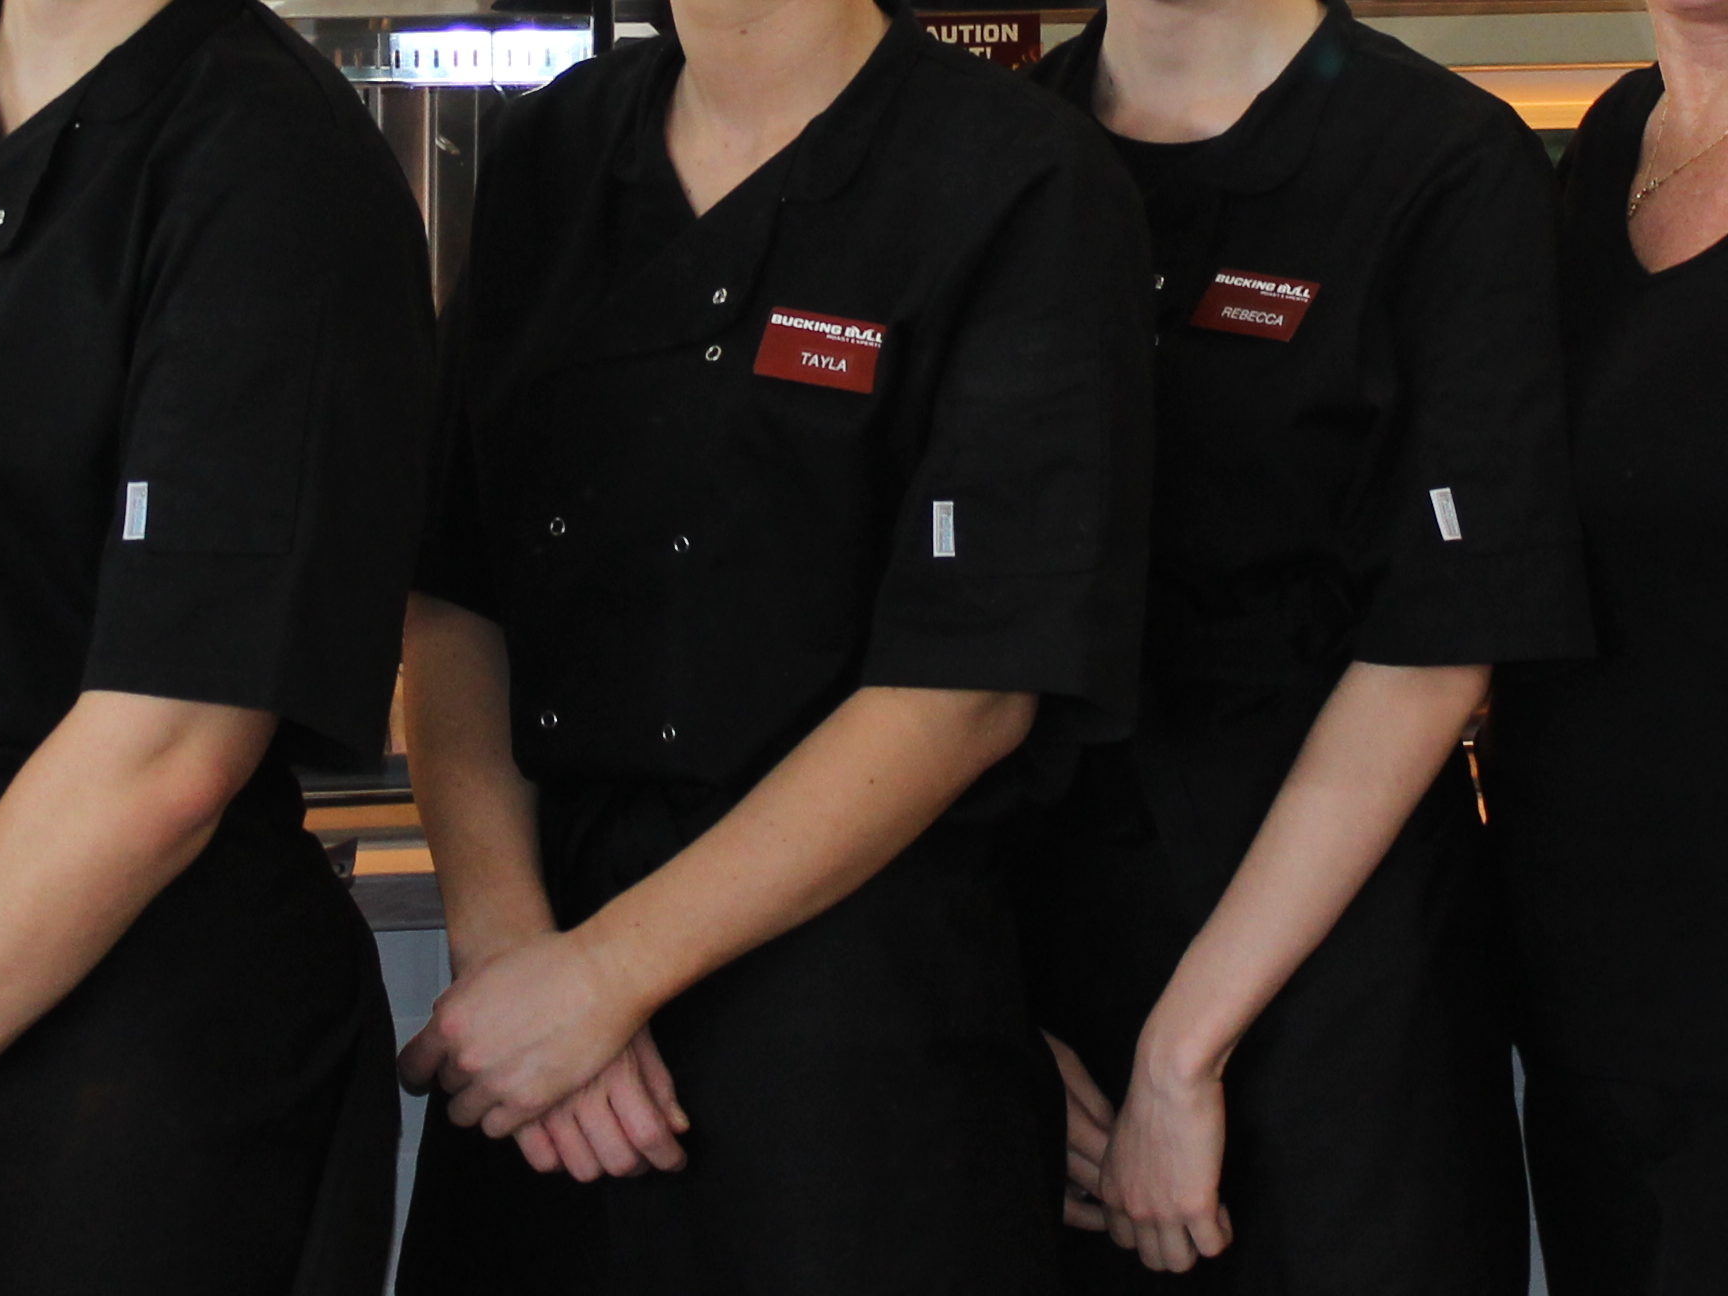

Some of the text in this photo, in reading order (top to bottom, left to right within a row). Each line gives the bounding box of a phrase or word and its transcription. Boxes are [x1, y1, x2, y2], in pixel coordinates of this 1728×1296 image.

[1215, 274, 1276, 292] BUCKING
[1277, 283, 1311, 298] BULL
[1221, 306, 1284, 326] REBECCA
[771, 313, 883, 343] BUCKING BULL
[801, 351, 848, 373] TAYLA
